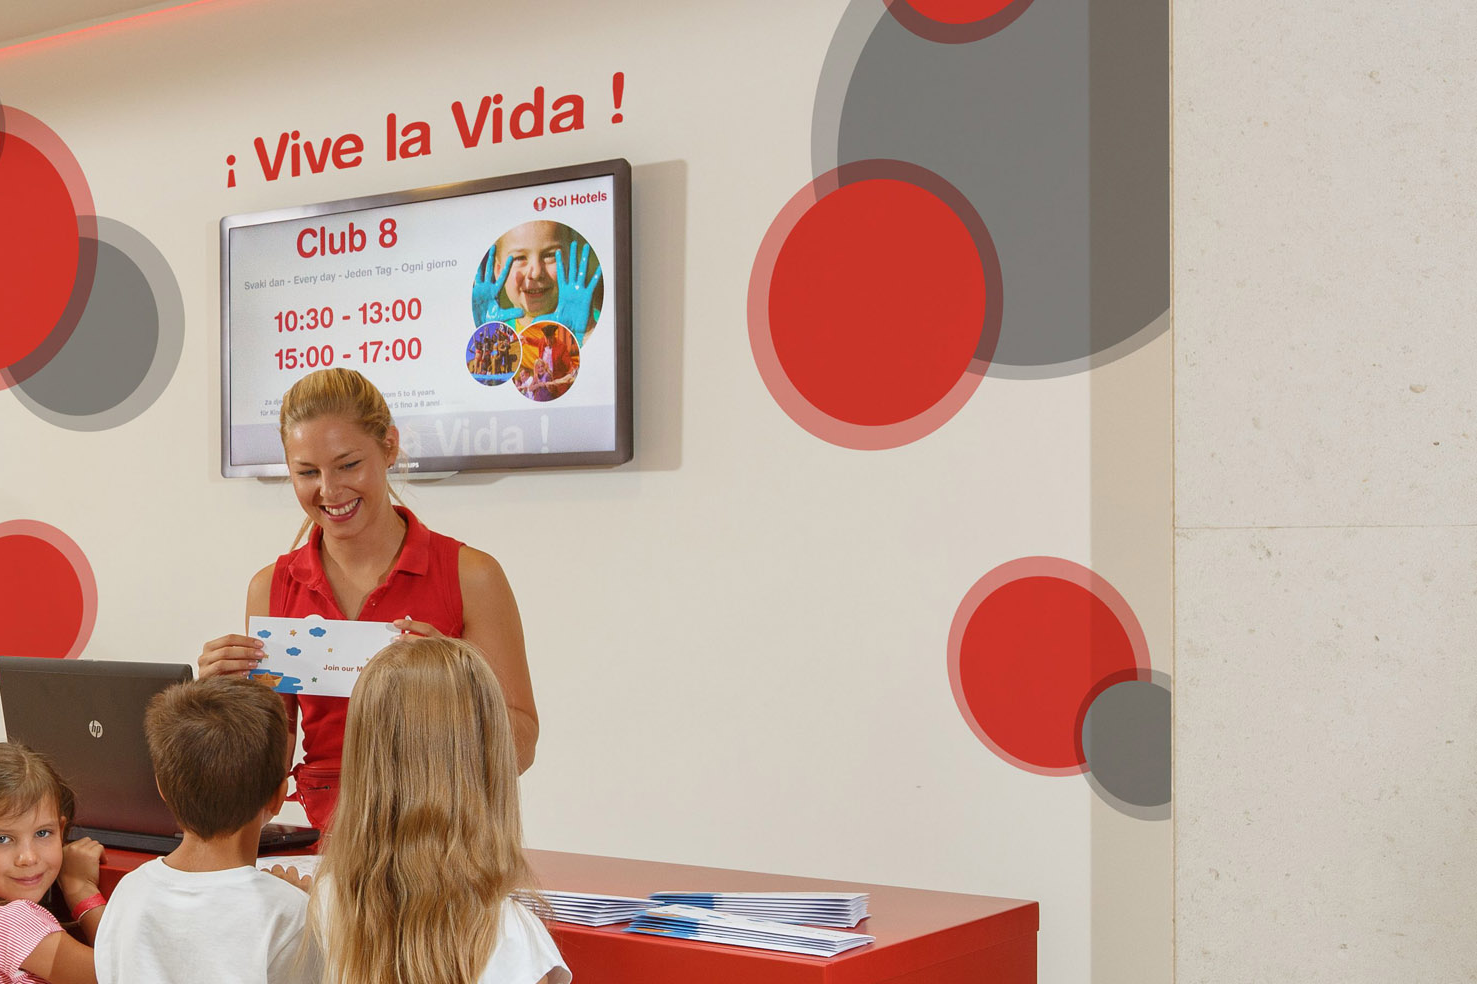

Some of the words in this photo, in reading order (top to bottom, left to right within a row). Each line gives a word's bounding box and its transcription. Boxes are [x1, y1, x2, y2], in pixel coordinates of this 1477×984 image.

[253, 130, 364, 182] Vive
[386, 112, 431, 162] la
[451, 85, 585, 149] Vida
[611, 71, 625, 125] !
[549, 195, 567, 208] Sol
[570, 190, 608, 206] Hotels
[296, 222, 367, 259] Club
[378, 218, 398, 249] 8
[244, 279, 267, 290] Svaki
[269, 278, 285, 288] dan
[293, 274, 318, 286] Every
[320, 272, 336, 283] day
[344, 269, 373, 280] Jeden
[375, 265, 392, 277] Tag
[401, 261, 424, 274] Ogni
[426, 259, 458, 272] giorno
[274, 306, 334, 333] 10:30
[358, 297, 422, 325] 13:00
[274, 344, 334, 370] 15:00
[359, 337, 422, 363] 17:00
[435, 416, 524, 457] Vida
